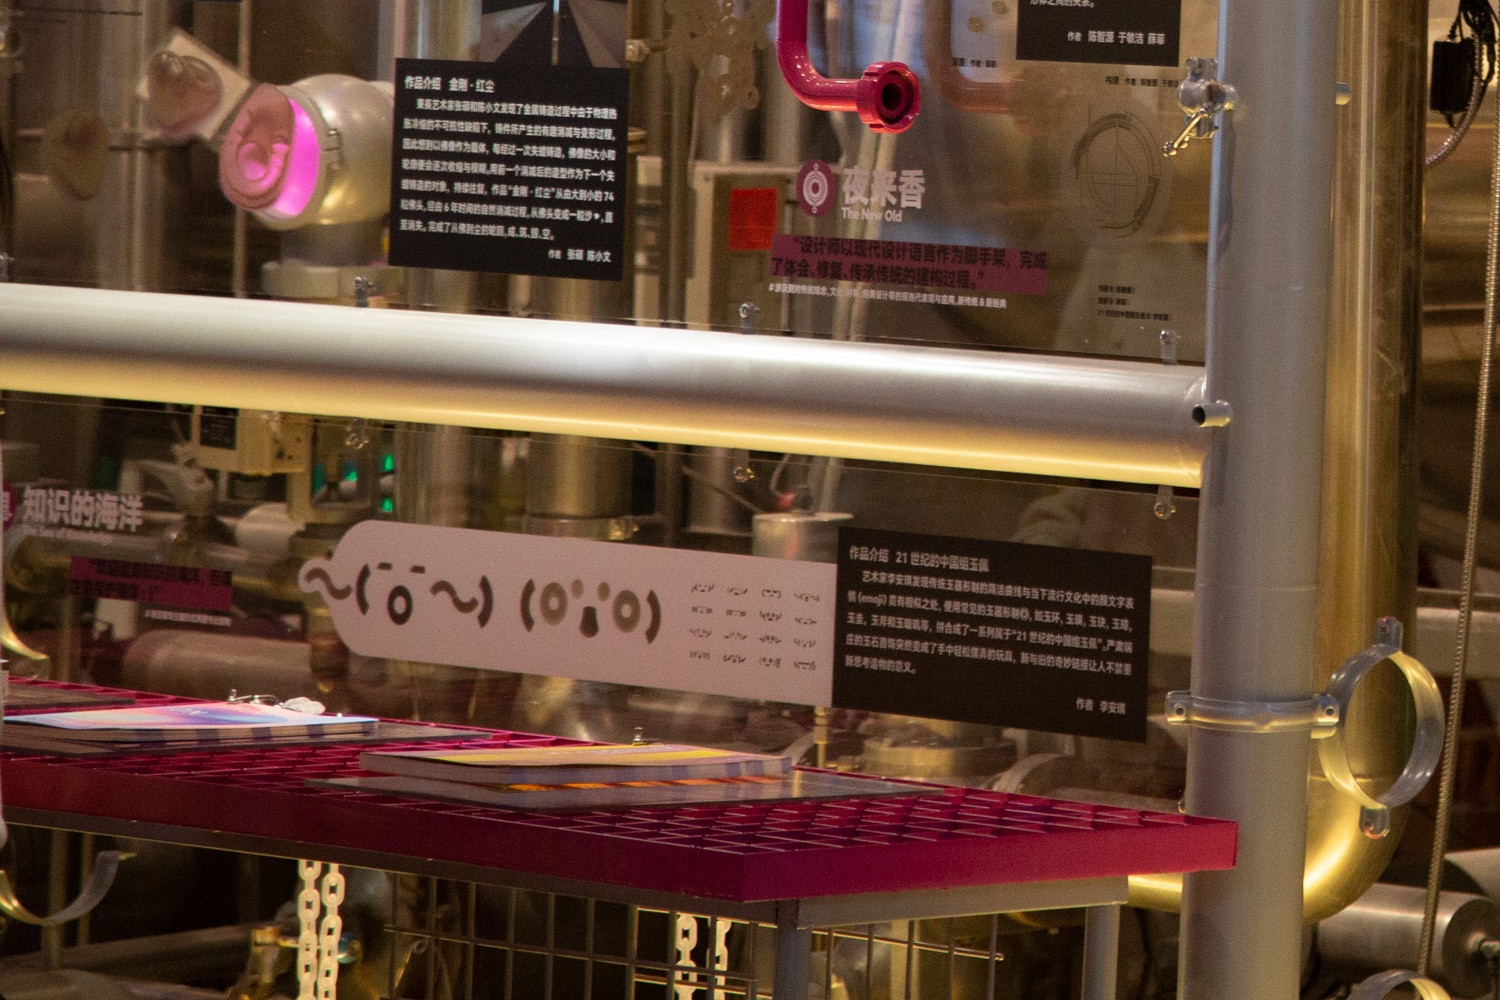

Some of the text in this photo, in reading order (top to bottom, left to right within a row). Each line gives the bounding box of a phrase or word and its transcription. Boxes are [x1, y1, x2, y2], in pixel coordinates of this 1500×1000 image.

[1067, 32, 1081, 42] 作者
[405, 76, 441, 90] 作品介绍
[843, 166, 925, 209] 夜来香
[604, 191, 614, 202] 74
[841, 207, 902, 223] The New Old
[548, 250, 561, 259] 作者
[23, 486, 144, 532] 知识的海洋
[849, 546, 888, 563] 作品介绍
[896, 551, 907, 563] 21
[1076, 697, 1093, 711] 作者
